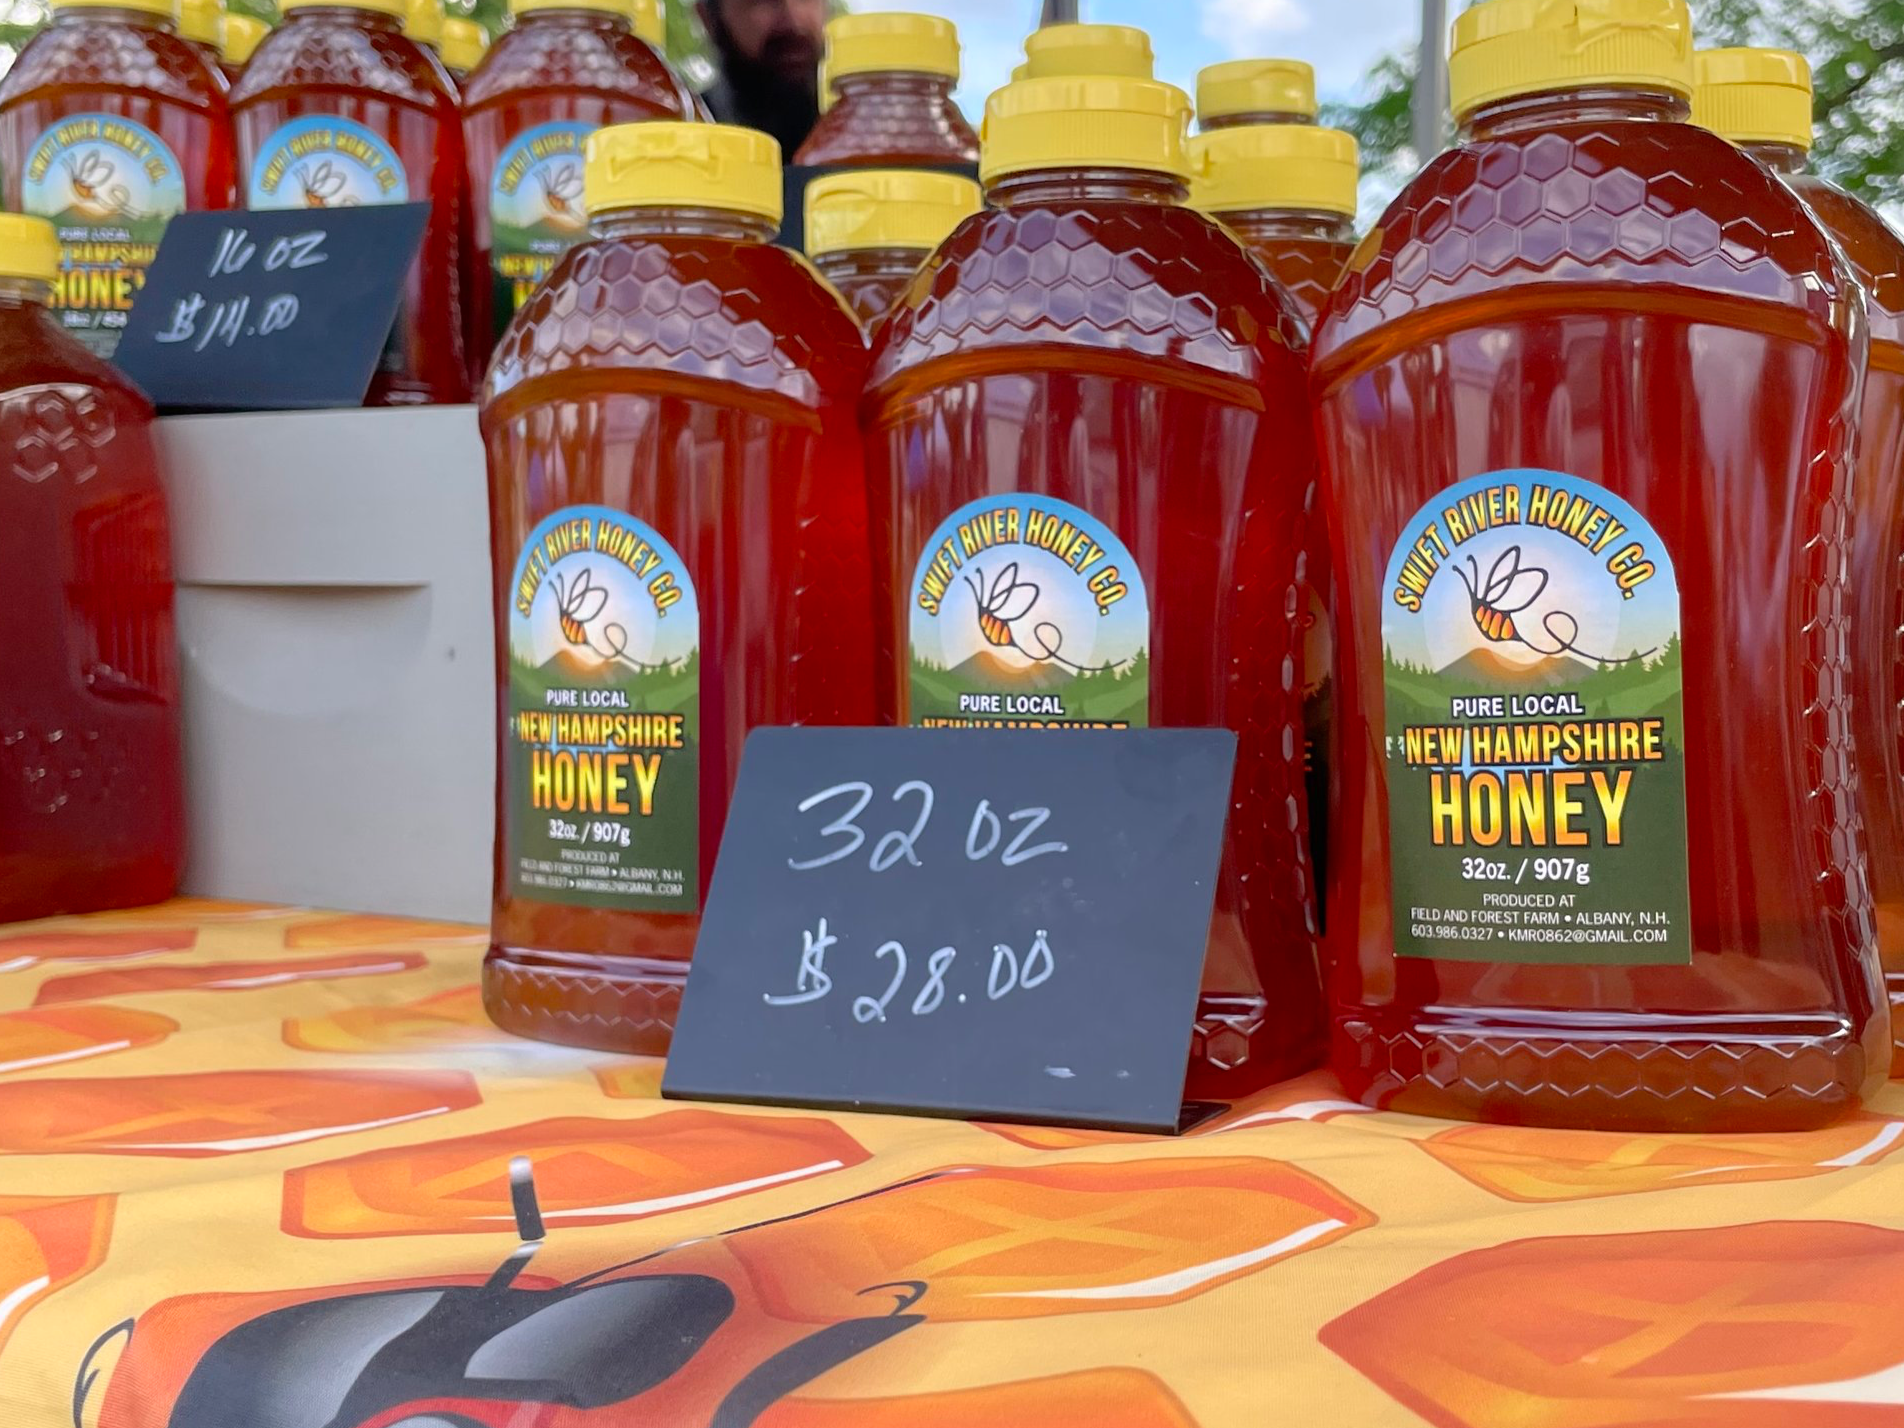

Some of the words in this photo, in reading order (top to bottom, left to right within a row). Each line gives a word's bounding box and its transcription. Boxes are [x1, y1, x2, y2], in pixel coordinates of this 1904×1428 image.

[208, 228, 256, 277] 16
[918, 537, 962, 616] SWIFT
[958, 507, 1019, 559] RIVER
[1024, 508, 1106, 575] HONEY
[1087, 565, 1127, 616] CO.
[1394, 522, 1450, 613] SWIFT
[1441, 484, 1521, 546] RIVER
[1526, 484, 1628, 556] HONEY
[1606, 542, 1656, 600] CO.
[516, 546, 547, 618] SWIFT
[544, 518, 591, 566] RIVER
[595, 518, 662, 580] HONEY
[648, 571, 682, 618] CO.
[546, 689, 578, 706] PURE
[582, 691, 629, 708] LOCAL
[959, 695, 1000, 712] PURE
[1006, 696, 1064, 714] LOCAL
[1452, 697, 1504, 717] PURE
[1512, 695, 1584, 716] LOCAL
[519, 712, 552, 743] NEW
[558, 713, 684, 748] HAMPSHIRE
[1405, 727, 1463, 764] NEW
[1472, 720, 1663, 764] HAMPSHIRE
[532, 750, 662, 815] HONEY
[788, 780, 935, 872] 32
[1430, 770, 1633, 846] HONEY
[593, 822, 631, 847] 907g
[1462, 857, 1511, 880] 32oz.
[1534, 858, 1590, 885] 907g
[1411, 908, 1440, 921] FIELD
[1443, 909, 1468, 922] AND
[1471, 910, 1520, 924] FOREST
[1524, 911, 1560, 925] FARM
[1575, 912, 1635, 927] ALBANY,
[1640, 912, 1671, 926] N.H.
[1483, 894, 1555, 907] PRODUCED
[1559, 895, 1576, 907] AT
[1411, 925, 1493, 940] 603.986.0327
